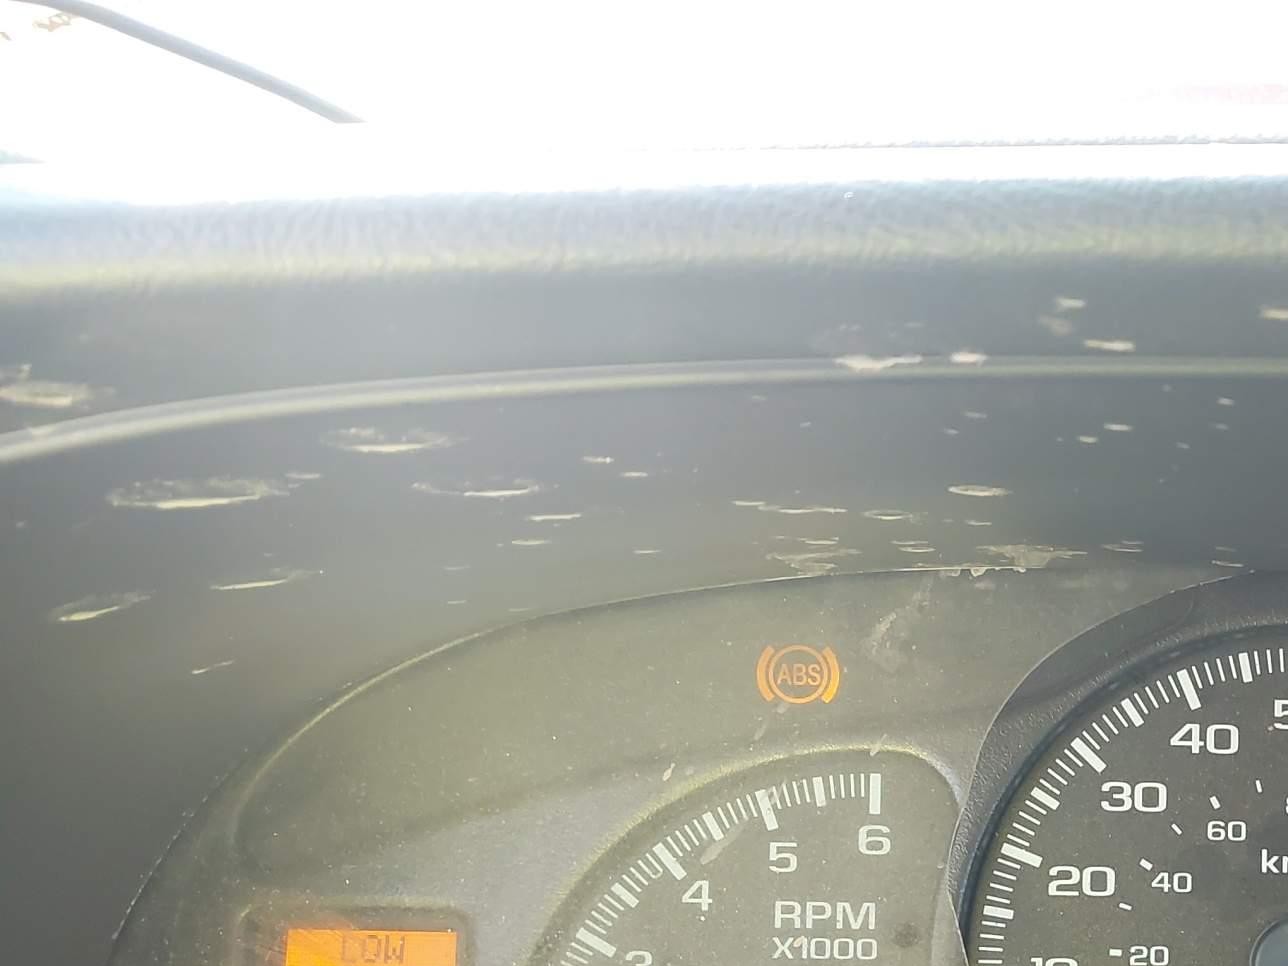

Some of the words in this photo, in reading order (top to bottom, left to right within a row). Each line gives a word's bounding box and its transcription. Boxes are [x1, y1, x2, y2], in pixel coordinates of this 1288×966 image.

[776, 664, 822, 687] ABS
[1171, 724, 1238, 754] 40
[1101, 782, 1166, 812] 30
[858, 825, 890, 854] 6
[1208, 821, 1246, 841] 60
[769, 842, 797, 873] 5
[1049, 866, 1115, 896] 20
[1152, 873, 1191, 892] 40
[682, 880, 712, 911] 4
[775, 901, 875, 929] RPM
[773, 936, 877, 959] X1000
[1130, 946, 1168, 966] 20
